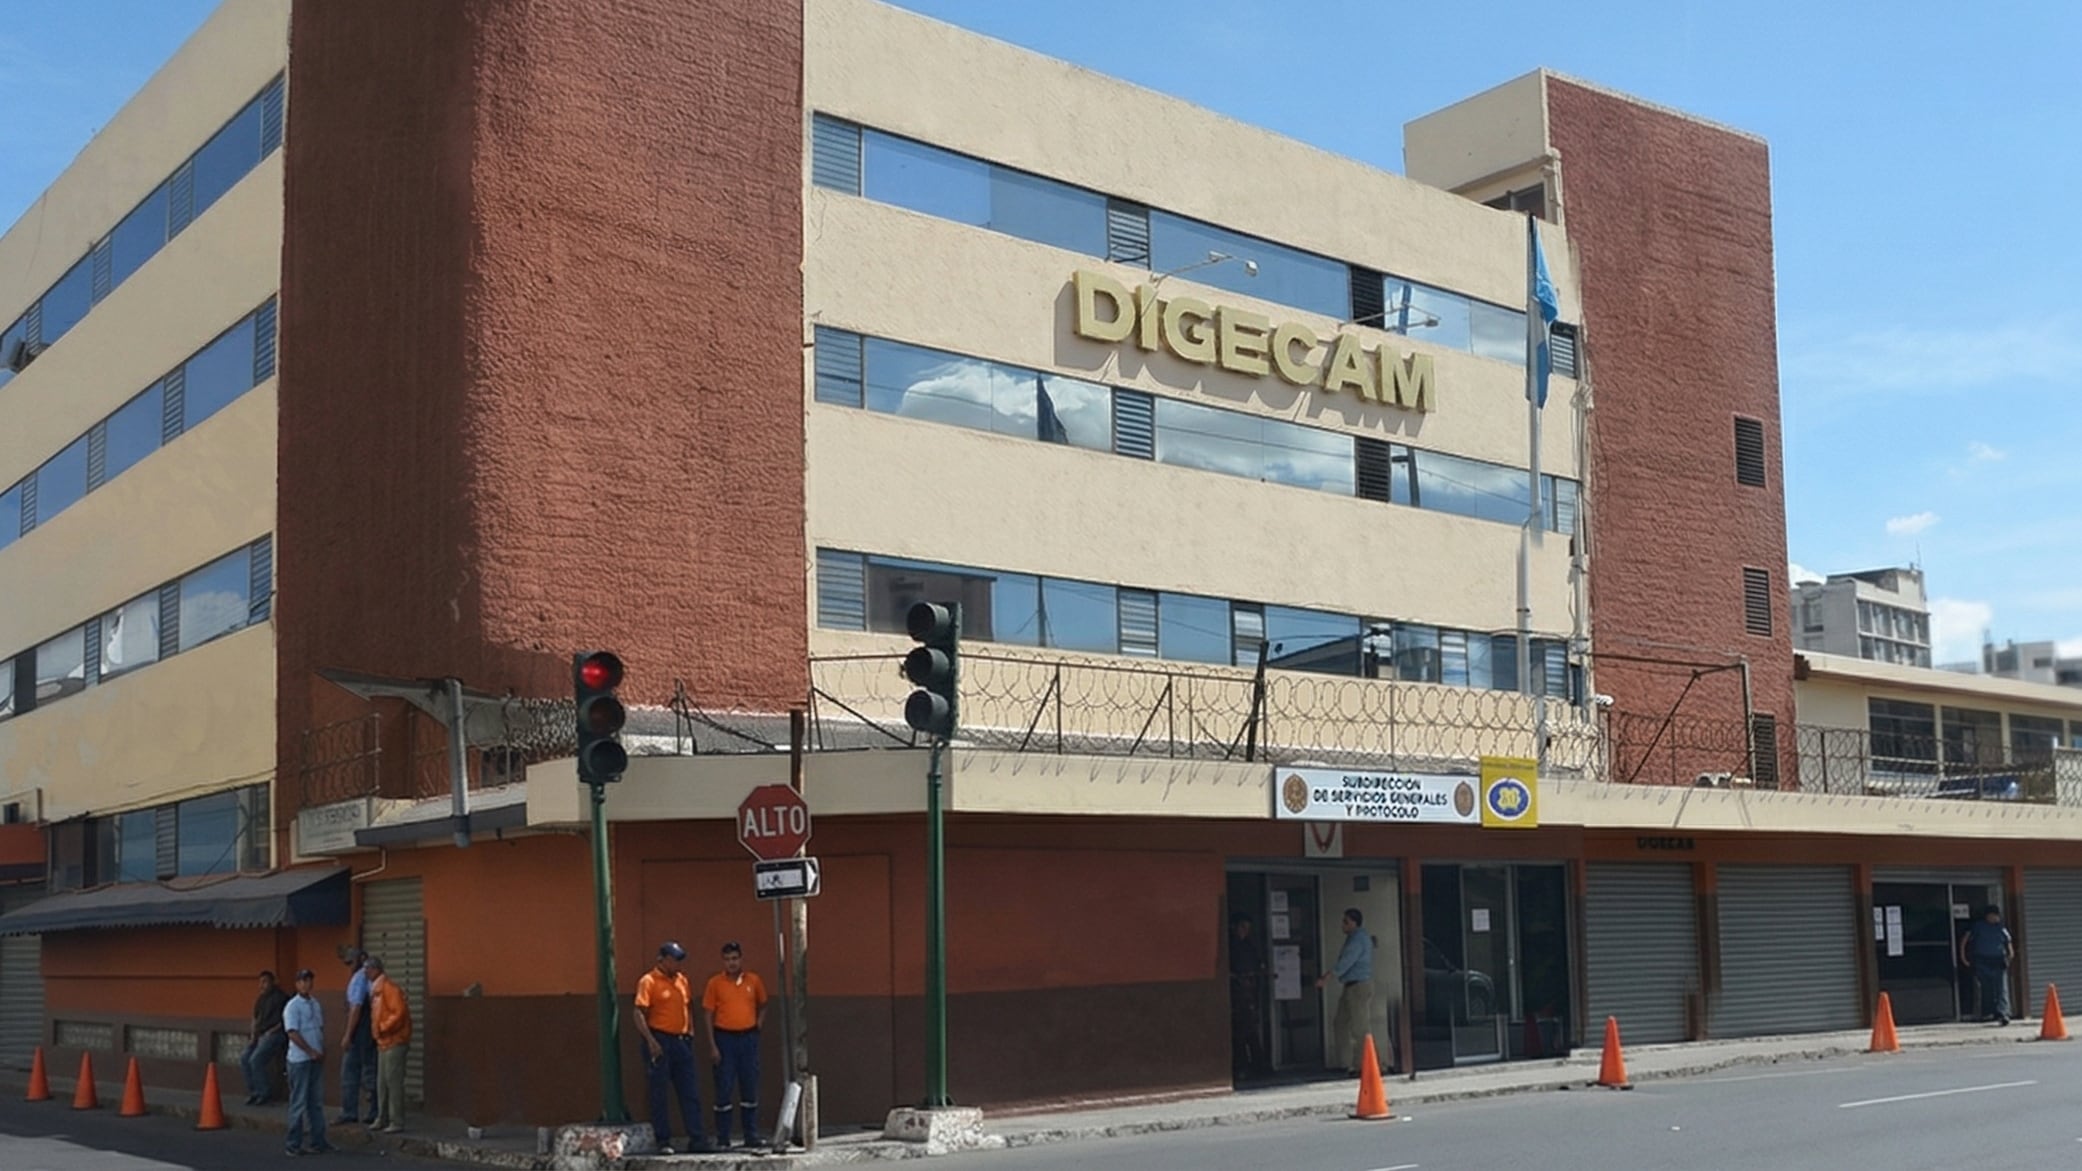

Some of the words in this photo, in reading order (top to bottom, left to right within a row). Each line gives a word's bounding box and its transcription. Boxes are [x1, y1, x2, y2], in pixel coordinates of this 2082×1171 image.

[1073, 270, 1436, 413] DIGECAM
[1313, 789, 1328, 802] DE
[1331, 789, 1387, 804] SERVICIOS
[1390, 791, 1448, 805] GENERALES
[743, 805, 806, 838] ALTO
[1345, 804, 1354, 816] Y
[1356, 804, 1419, 818] PROTOCOLO
